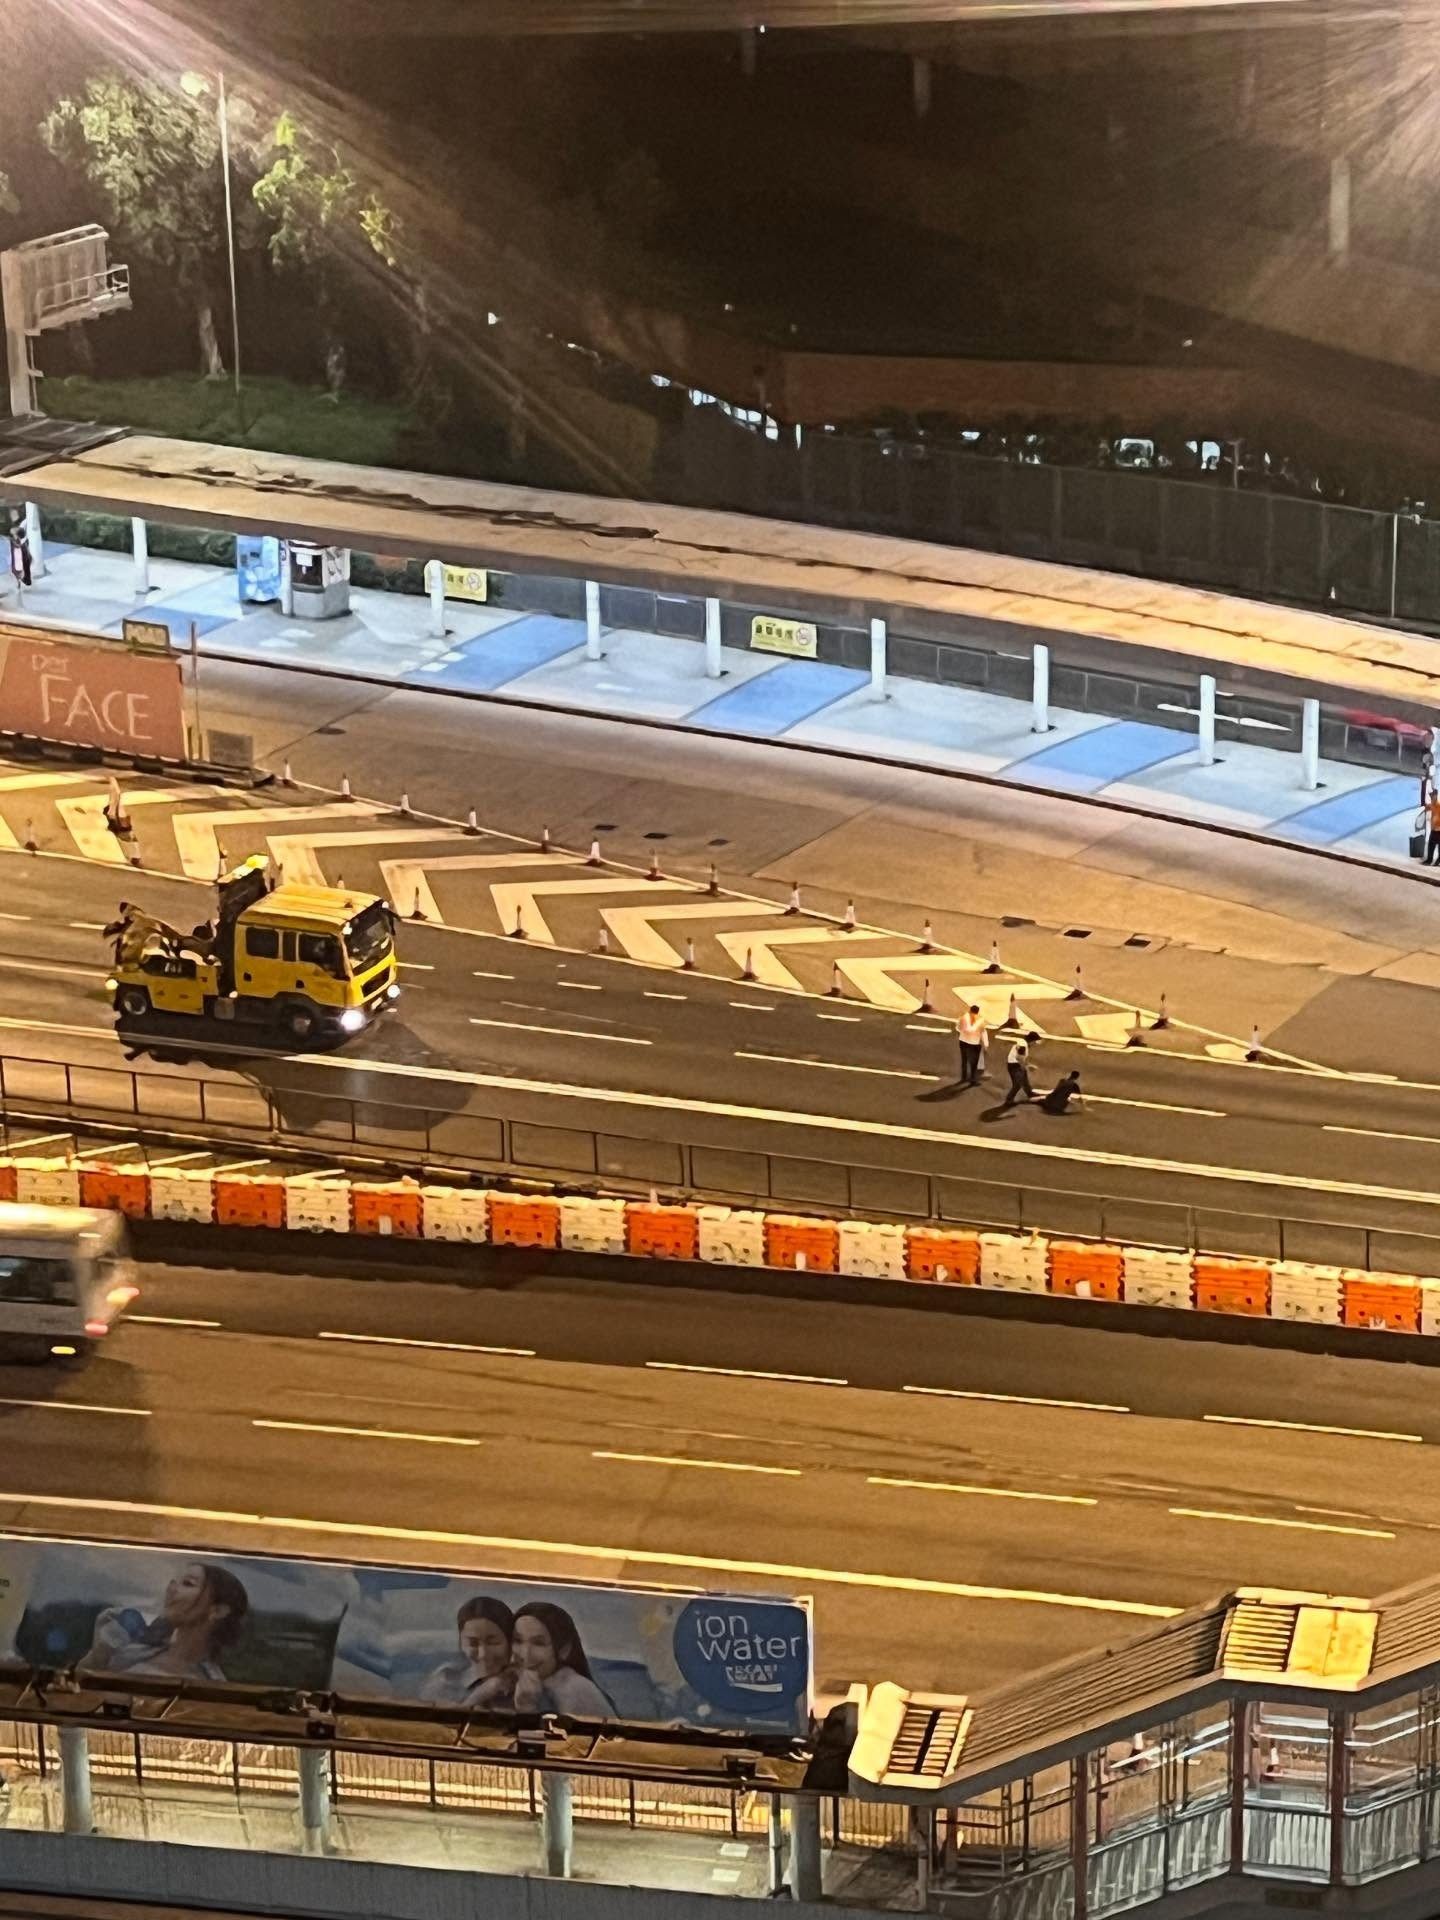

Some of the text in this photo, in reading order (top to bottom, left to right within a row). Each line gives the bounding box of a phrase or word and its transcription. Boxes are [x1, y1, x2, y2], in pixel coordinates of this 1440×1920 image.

[40, 673, 152, 739] FACE
[695, 1610, 748, 1638] ion
[697, 1634, 801, 1660] water
